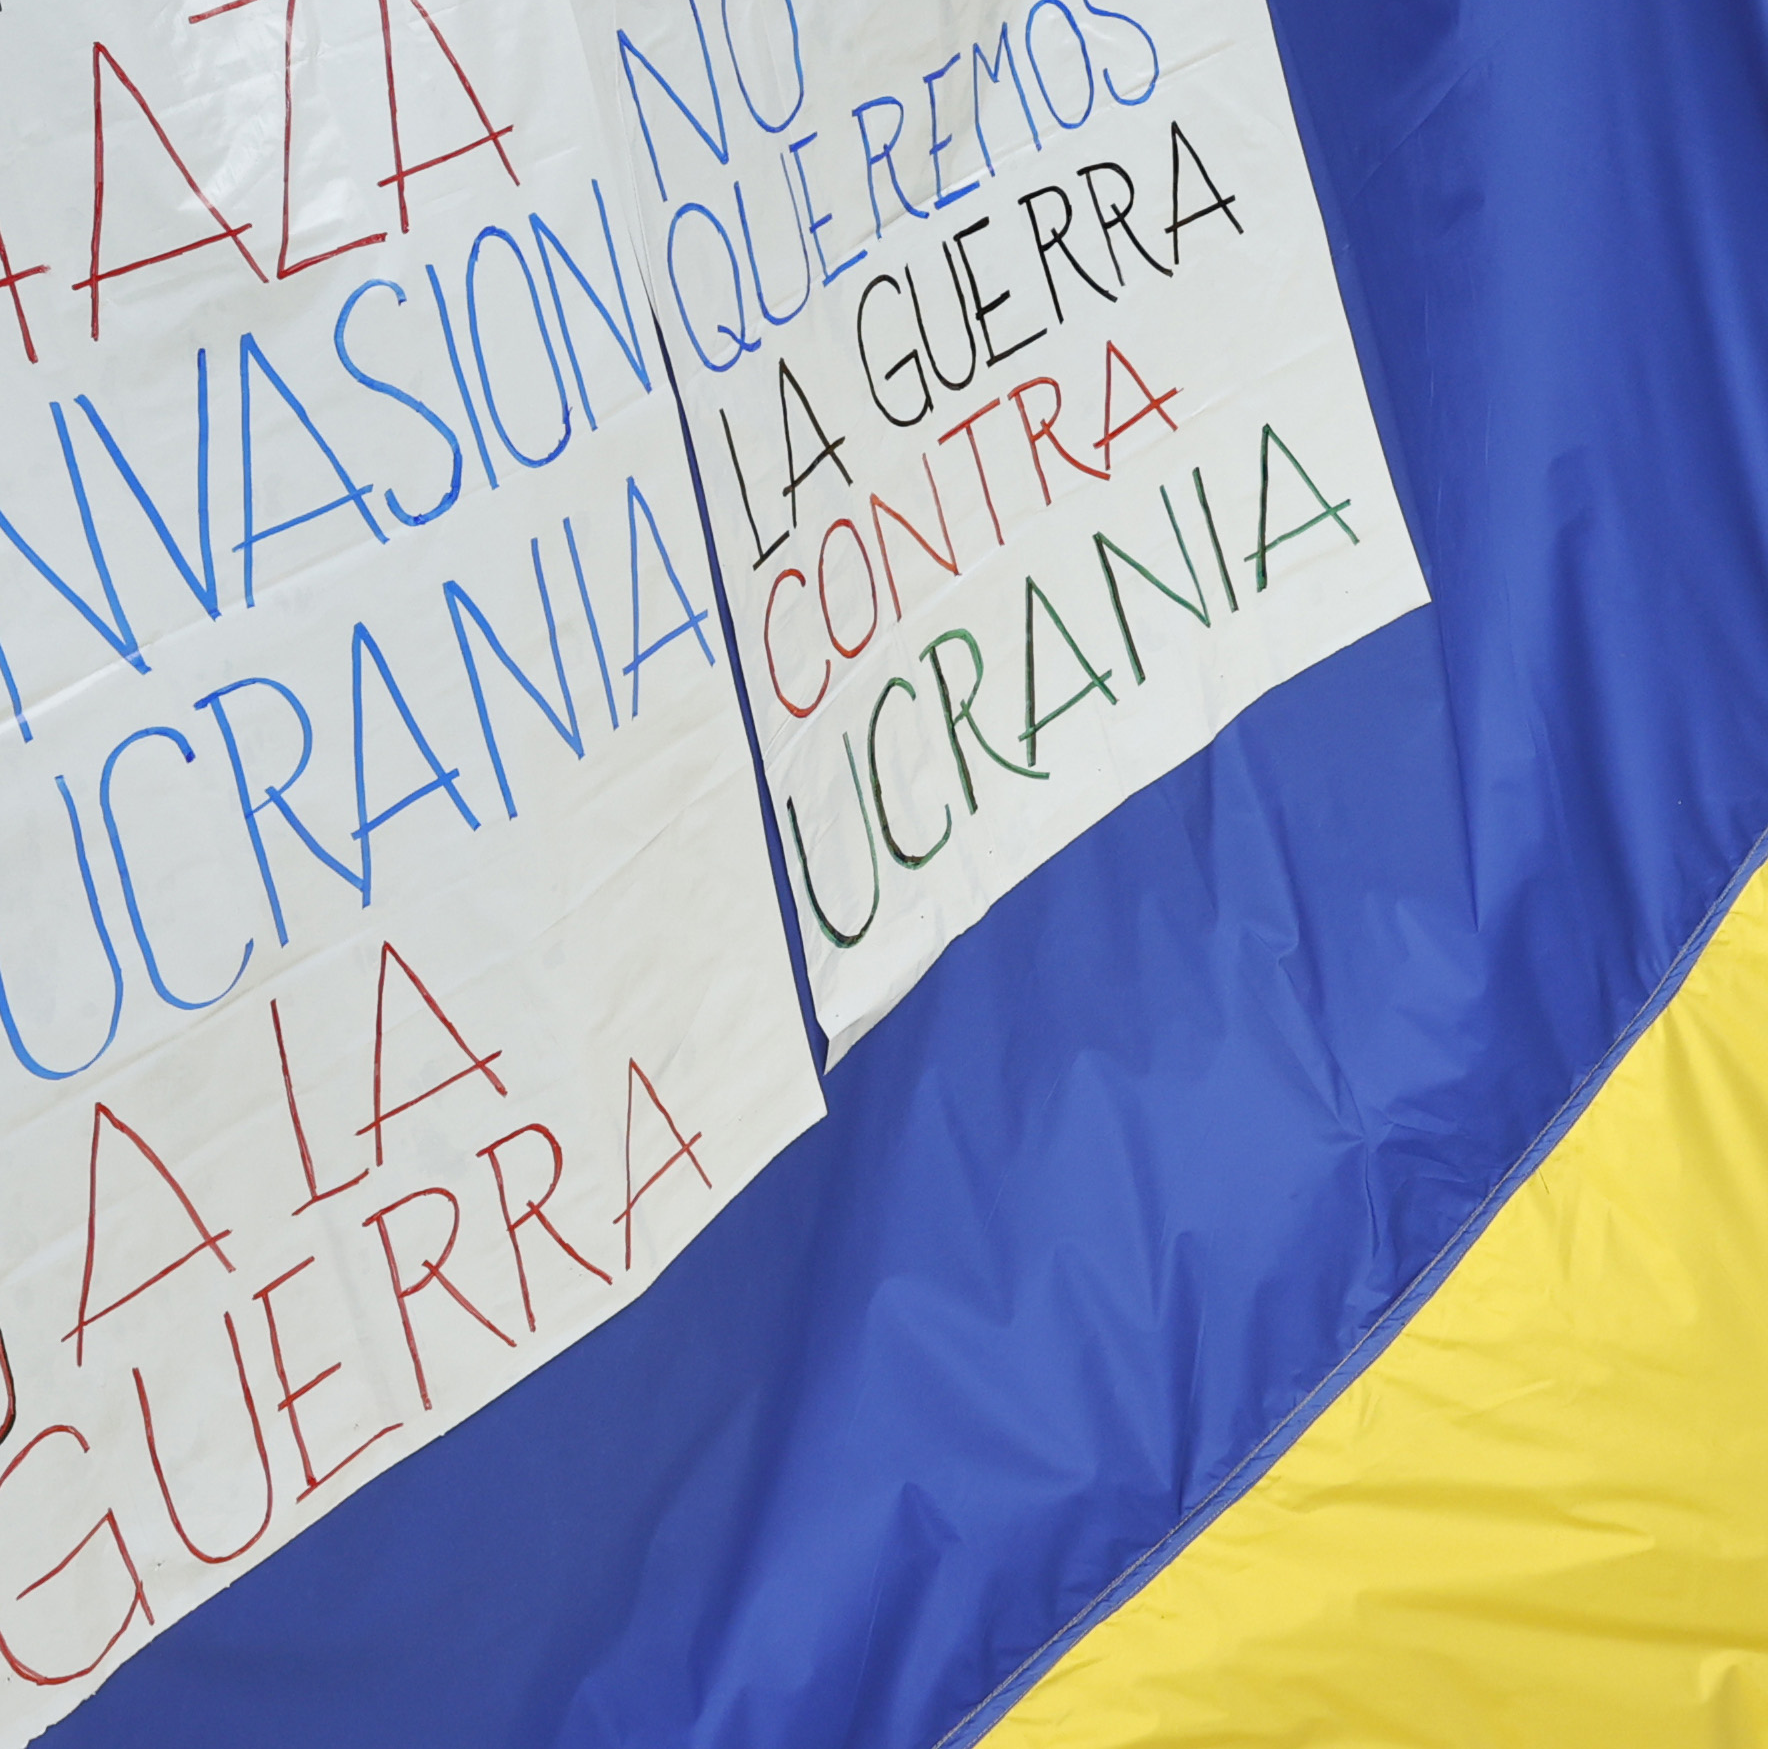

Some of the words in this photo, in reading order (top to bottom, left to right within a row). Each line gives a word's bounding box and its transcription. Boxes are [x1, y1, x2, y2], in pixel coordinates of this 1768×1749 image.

[720, 358, 854, 571] LA
[855, 121, 1244, 428] GUERRA
[764, 340, 1185, 719] CONTRA
[786, 423, 1360, 949] UCRANIA
[61, 1101, 235, 1366] A
[270, 941, 507, 1216] LA
